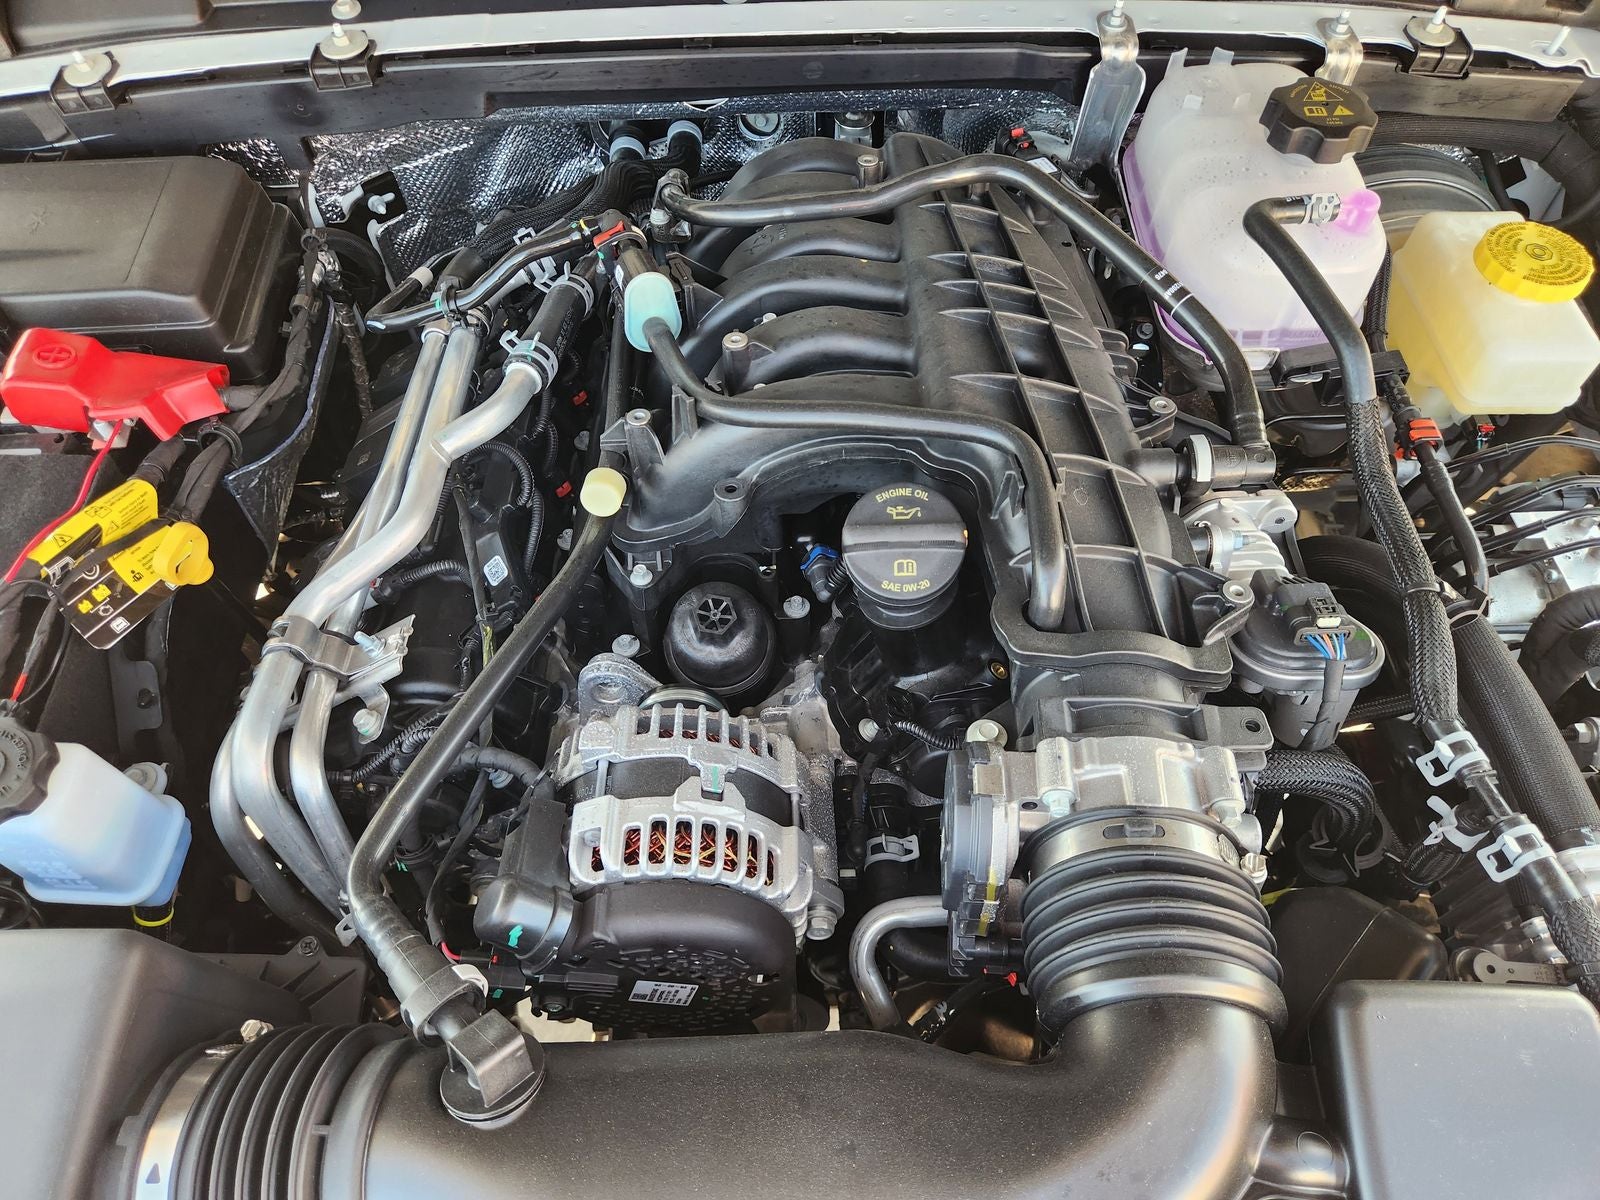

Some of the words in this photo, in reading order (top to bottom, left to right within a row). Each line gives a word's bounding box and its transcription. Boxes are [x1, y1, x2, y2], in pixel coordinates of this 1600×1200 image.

[875, 488, 913, 503] ENGINE
[914, 489, 930, 502] OIL
[881, 580, 901, 592] SAE
[903, 579, 930, 592] 0W-20
